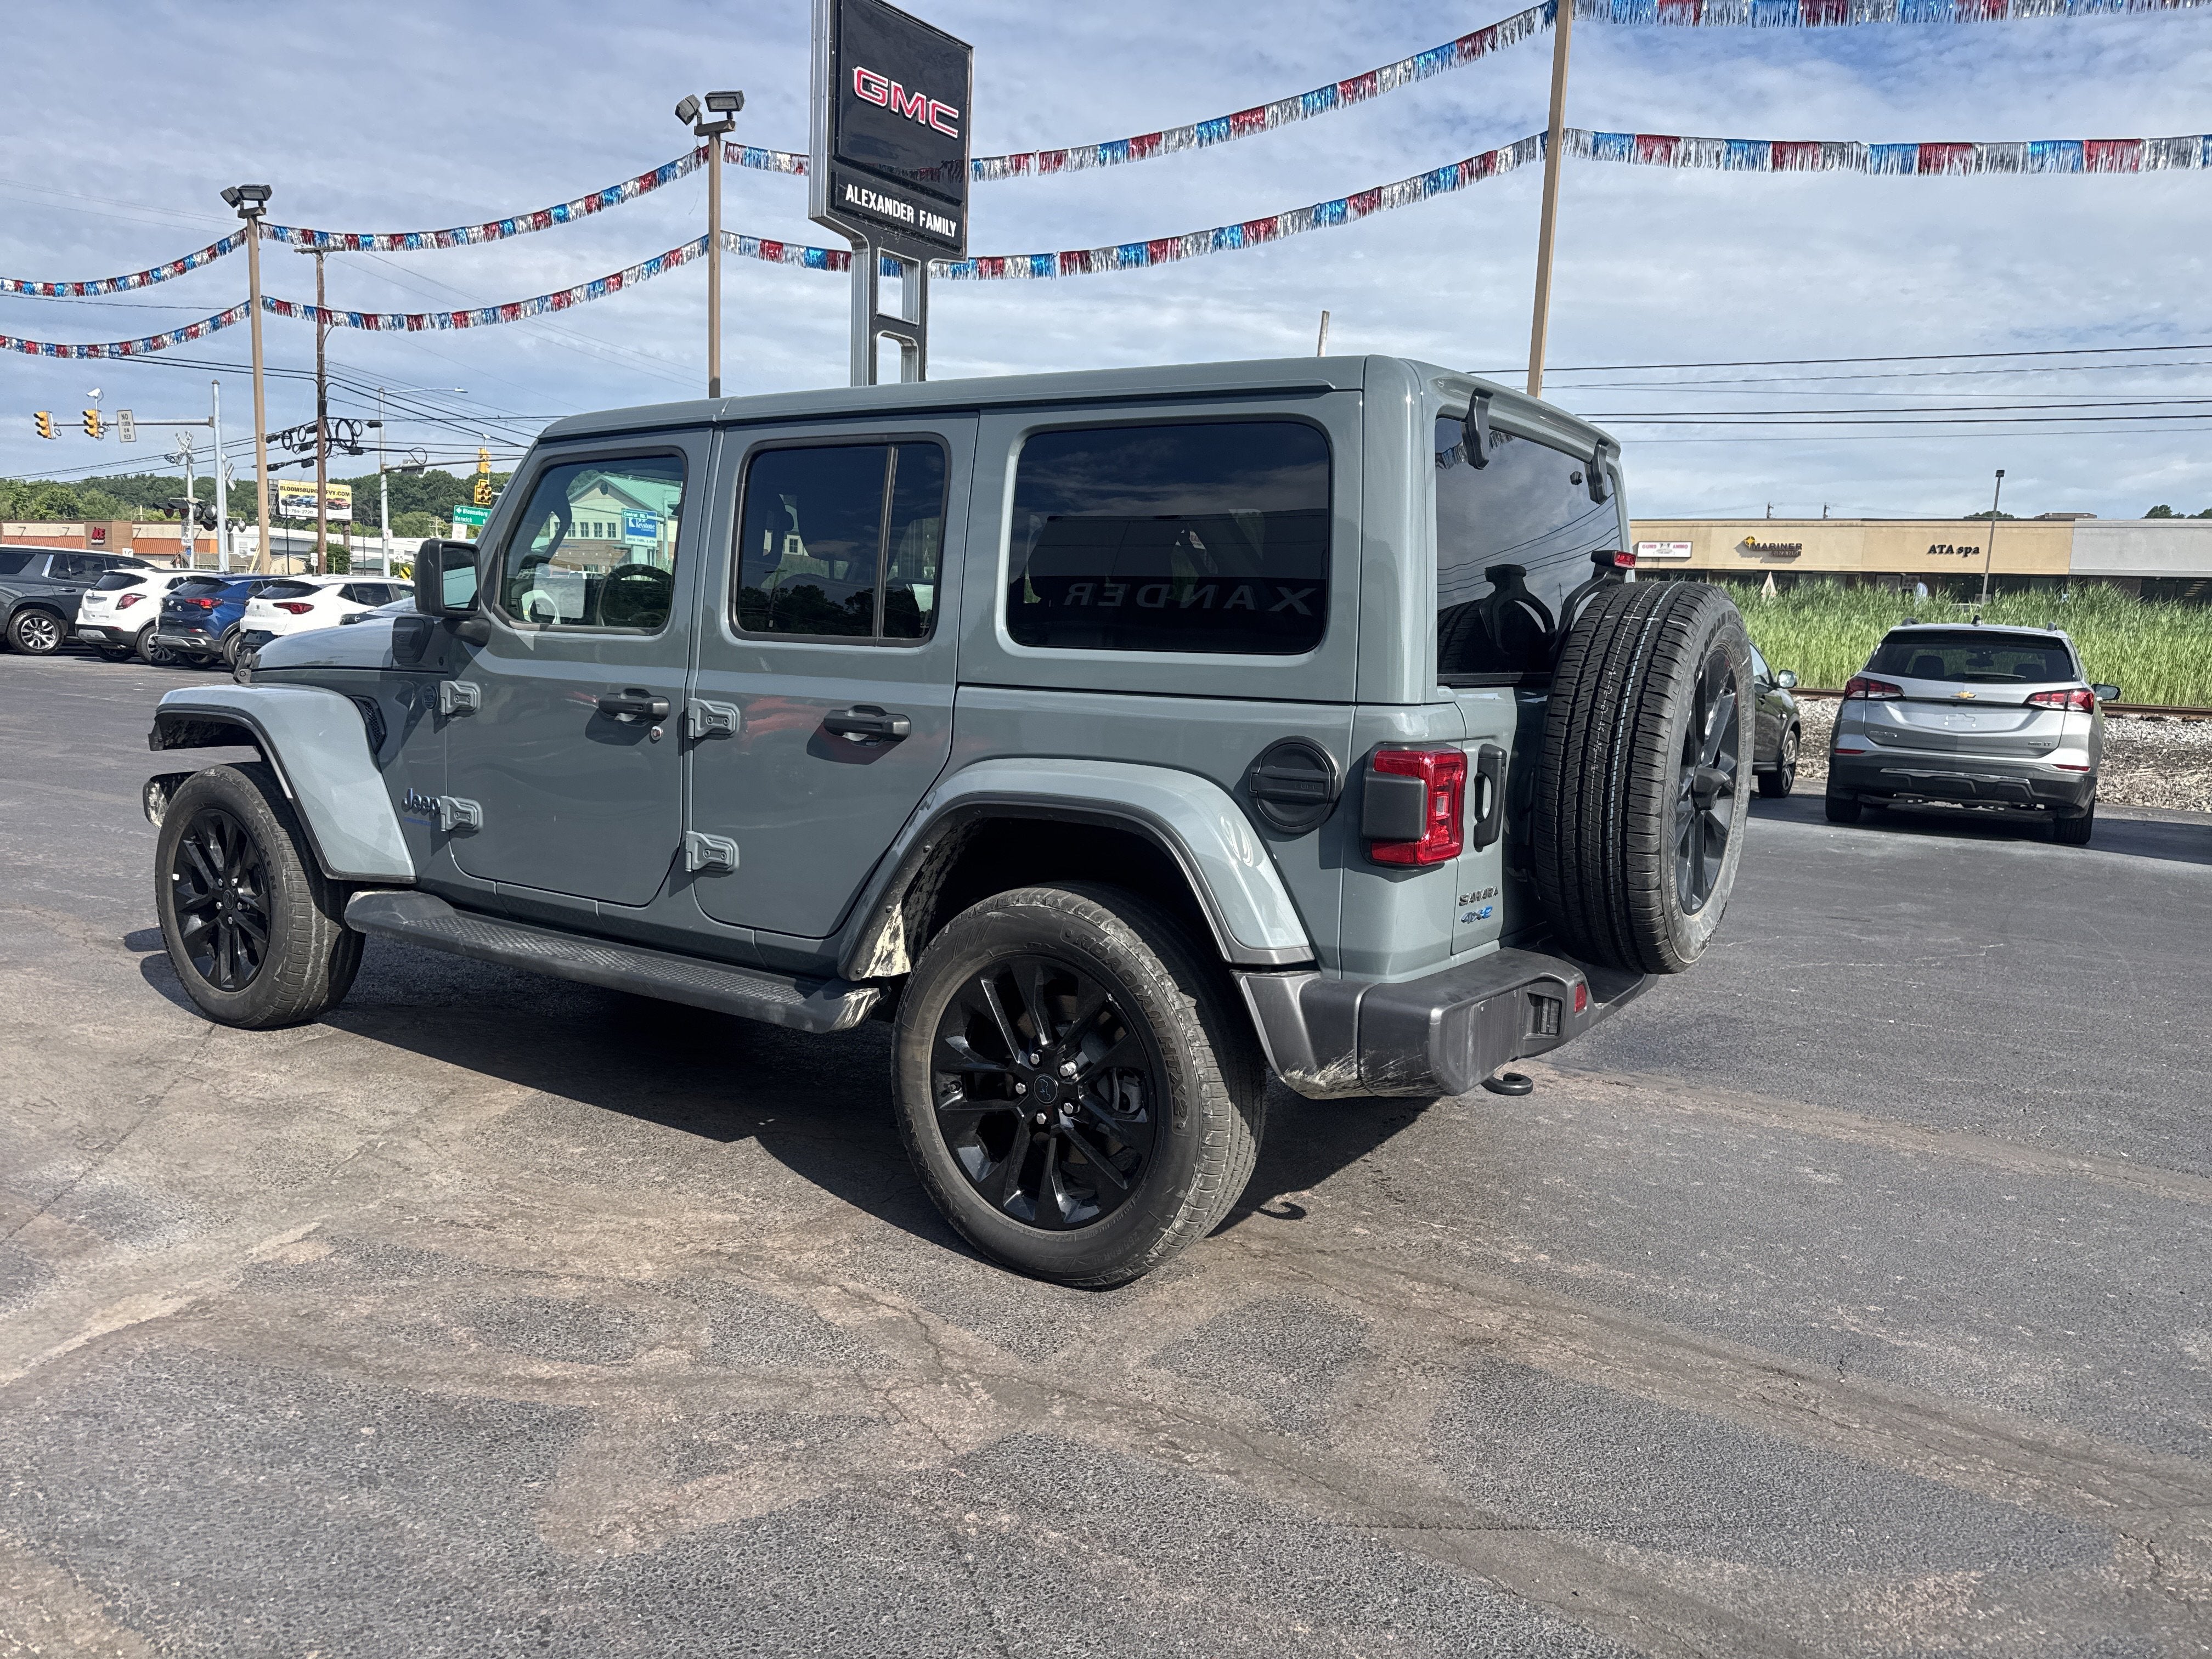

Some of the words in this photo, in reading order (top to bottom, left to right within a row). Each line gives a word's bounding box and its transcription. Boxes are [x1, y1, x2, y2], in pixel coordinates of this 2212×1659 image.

[853, 66, 959, 139] GMC
[845, 184, 914, 223] ALEXANDER
[919, 210, 956, 239] FAMILY
[280, 486, 350, 496] BLOOMSBURGEVY.COM
[462, 508, 488, 517] Bloomsburg
[91, 527, 105, 539] ACE
[1927, 544, 1954, 554] ATA
[1957, 546, 1980, 557] spa
[401, 788, 441, 819] Jeep
[1459, 885, 1498, 906] SAHARA
[1073, 932, 1167, 1029] ROADIAN
